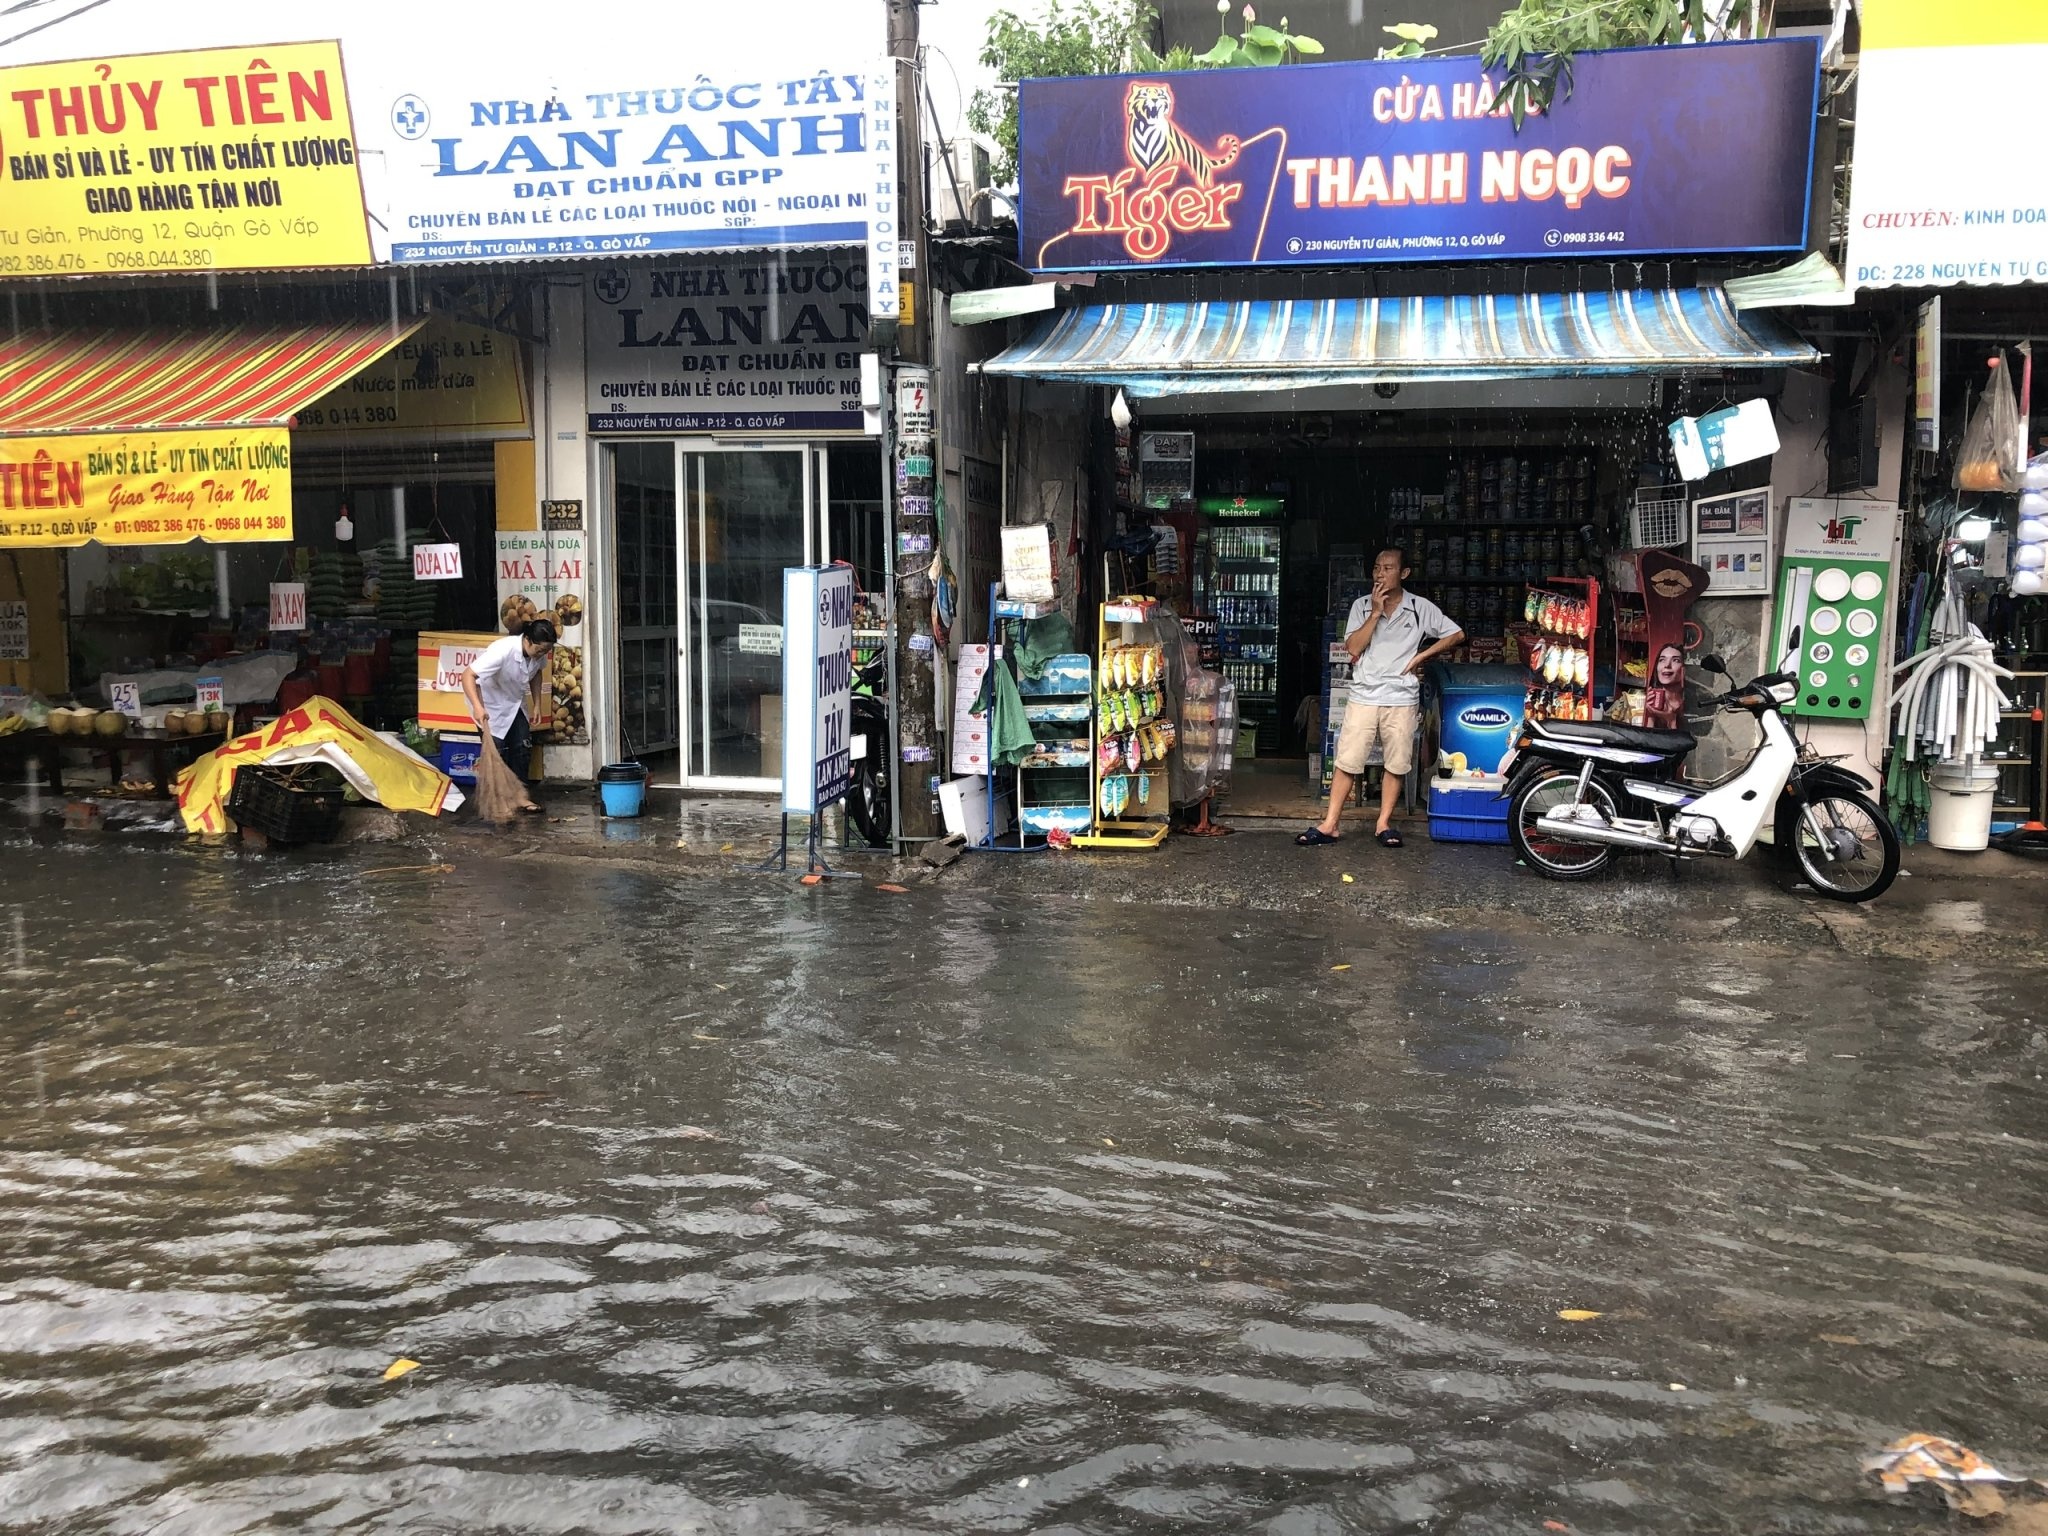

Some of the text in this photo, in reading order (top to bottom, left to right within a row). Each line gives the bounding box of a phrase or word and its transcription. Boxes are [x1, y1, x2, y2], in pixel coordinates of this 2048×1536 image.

[11, 58, 333, 138] THỦY TIÊN
[470, 70, 865, 127] NHÀ THUỐC TÂY
[1373, 75, 1444, 123] CỬA
[9, 134, 354, 181] BÁN SỈ VÀ LẺ UY TÍN CHẤT LƯỢNG
[431, 112, 867, 177] LAN ANH
[513, 167, 783, 201] ĐẠT CHUẨN GPP
[1287, 145, 1631, 209] THANH NGỌC
[86, 177, 282, 213] GIAO HÀNG TẬN NƠI
[408, 210, 481, 229] CHUYÊN
[487, 208, 525, 226] BÁN
[532, 204, 553, 223] LẺ
[559, 206, 597, 222] CÁC
[604, 204, 646, 222] LOẠI
[722, 196, 757, 216] NỘI
[777, 193, 840, 212] NGOẠI
[1063, 165, 1243, 259] Tiger
[1863, 208, 1960, 229] CHUYÊN:
[1964, 209, 2005, 224] KINH
[79, 223, 143, 244] Phường
[185, 219, 235, 239] Quận
[243, 218, 271, 236] Gò
[283, 215, 318, 236] Vấp
[1306, 240, 1323, 251] 230
[1324, 235, 1361, 250] NGUYỄN
[1362, 238, 1375, 249] TƯ
[1376, 235, 1401, 251] GIẢN,
[1403, 233, 1443, 248] PHƯỜNG
[1446, 236, 1459, 248] 12,
[1471, 233, 1486, 246] GÒ
[1487, 231, 1506, 245] VẤP
[1564, 231, 1624, 243] 0908 336 442
[108, 248, 212, 268] 0968.044.380
[405, 247, 426, 258] 232
[429, 241, 482, 256] NGUYỄN
[485, 243, 502, 254] TƯ
[505, 241, 537, 254] GIẢN
[548, 242, 572, 253] P.12
[601, 238, 621, 250] GÒ
[625, 236, 651, 249] VẤP
[650, 264, 730, 298] NHÀ
[1858, 265, 1886, 281] ĐC:
[1893, 264, 1925, 280] 228
[618, 305, 767, 347] LAN
[682, 345, 826, 376] ĐẠT CHUẨN
[600, 379, 656, 398] CHUYÊN
[661, 378, 690, 397] BÁN
[695, 376, 711, 396] LẺ
[716, 378, 746, 397] CÁC
[750, 379, 783, 400] LOẠI
[787, 375, 836, 396] THUỐC
[598, 413, 786, 429] 232 NGUYỄN TƯ GIẢN P.12 Q. GÒ VẤP
[611, 403, 627, 412] DS:
[88, 437, 288, 476] BÁN SỈ & LẺ UY TÍN CHẤT LƯỢNG
[0, 449, 84, 510] TIÊN
[109, 478, 270, 513] Giao Hàng Tận Nơi
[546, 503, 578, 519] 232
[21, 516, 286, 536] P.12 Q.GÒ VẤP ĐT: 0982 386 476 0968 044 380
[1218, 508, 1261, 517] Heineken
[500, 535, 580, 549] ĐIỂM BÁN DỪA
[415, 547, 460, 575] DỪA LY
[501, 555, 582, 579] MÃ LAI
[524, 583, 541, 592] BẾN
[832, 575, 850, 628] NHÀ
[284, 592, 305, 624] XAY
[818, 634, 850, 699] THUỐC
[200, 690, 220, 702] 13K
[825, 703, 844, 756] TÂY
[1464, 713, 1508, 722] VINAMILK
[817, 752, 848, 790] LAN ANH
